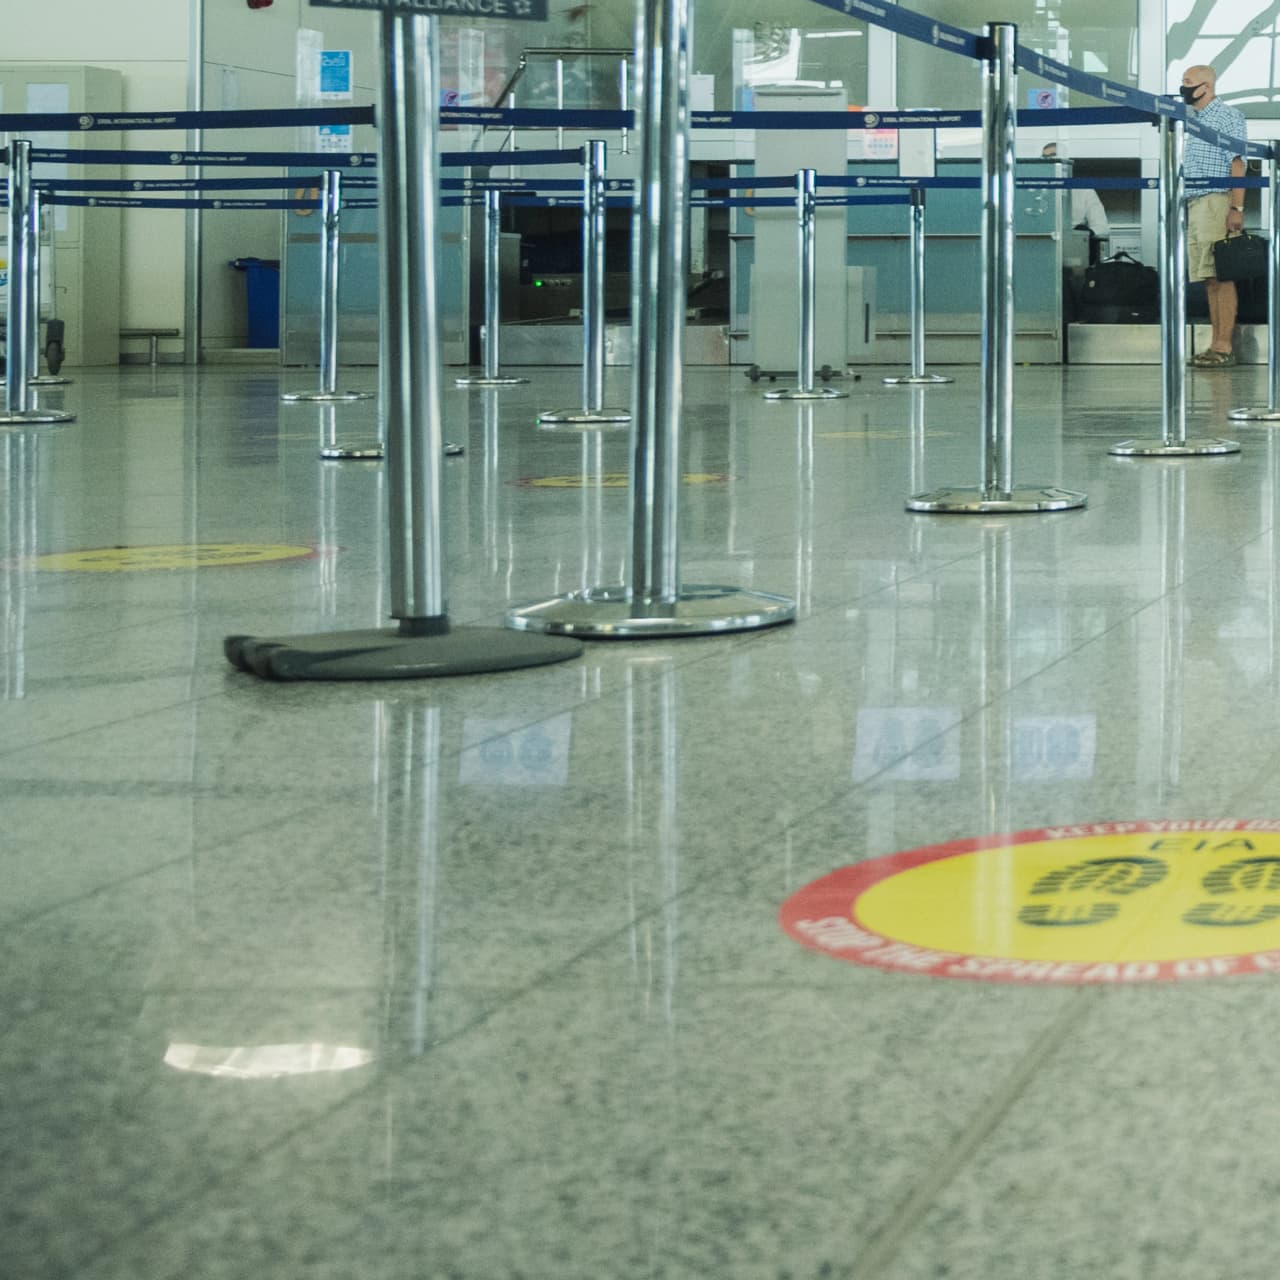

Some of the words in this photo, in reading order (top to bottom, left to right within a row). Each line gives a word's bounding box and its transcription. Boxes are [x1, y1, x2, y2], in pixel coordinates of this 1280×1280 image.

[1045, 821, 1136, 839] KEEP
[1146, 819, 1238, 832] YOUR
[1150, 838, 1255, 852] EIA
[1174, 958, 1238, 975] OF
